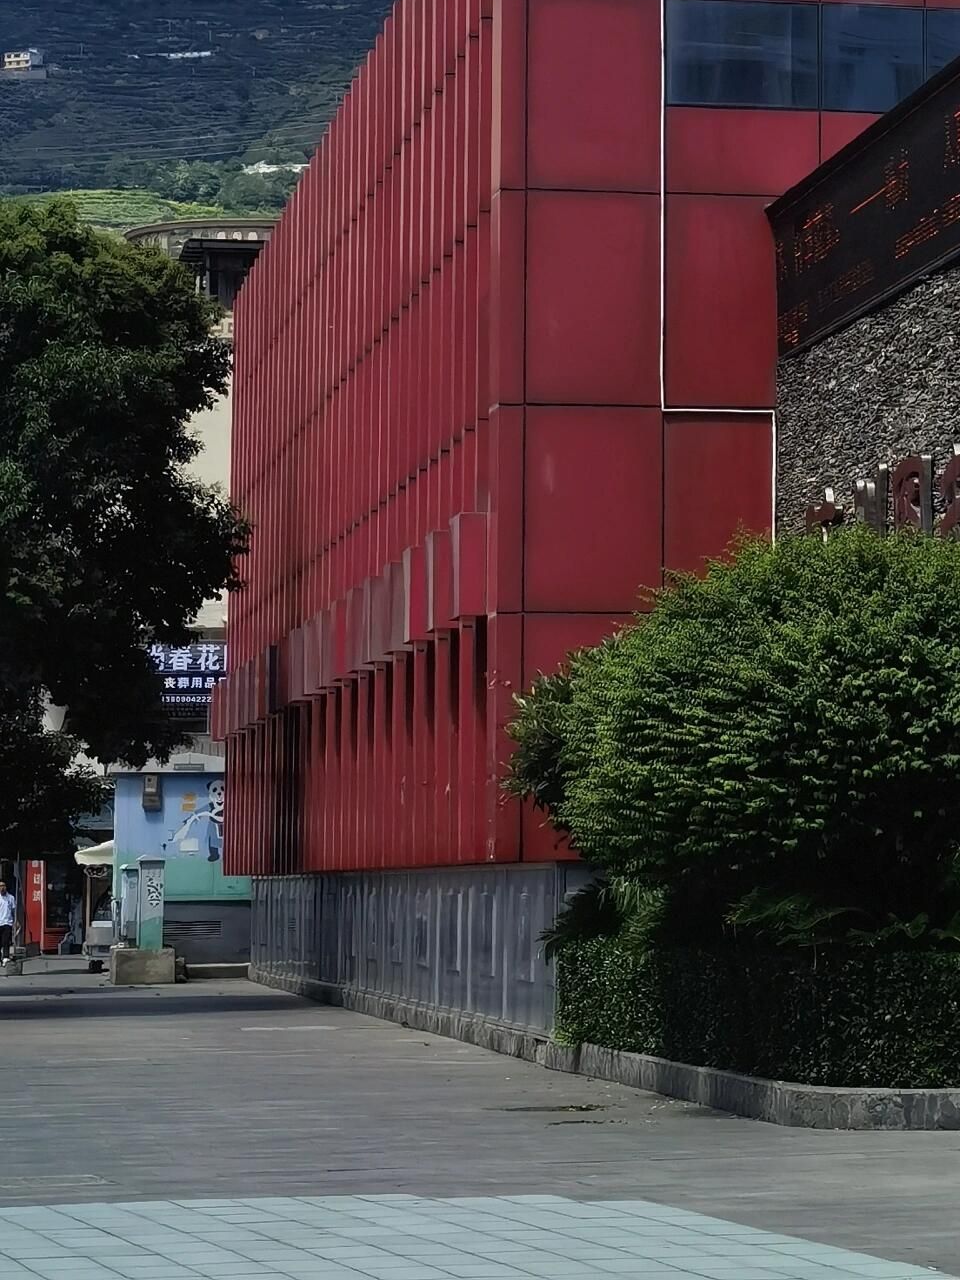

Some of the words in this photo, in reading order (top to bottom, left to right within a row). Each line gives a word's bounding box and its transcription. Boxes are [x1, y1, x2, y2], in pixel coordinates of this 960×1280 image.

[149, 643, 228, 671] 春花
[164, 676, 227, 689] 丧葬用品
